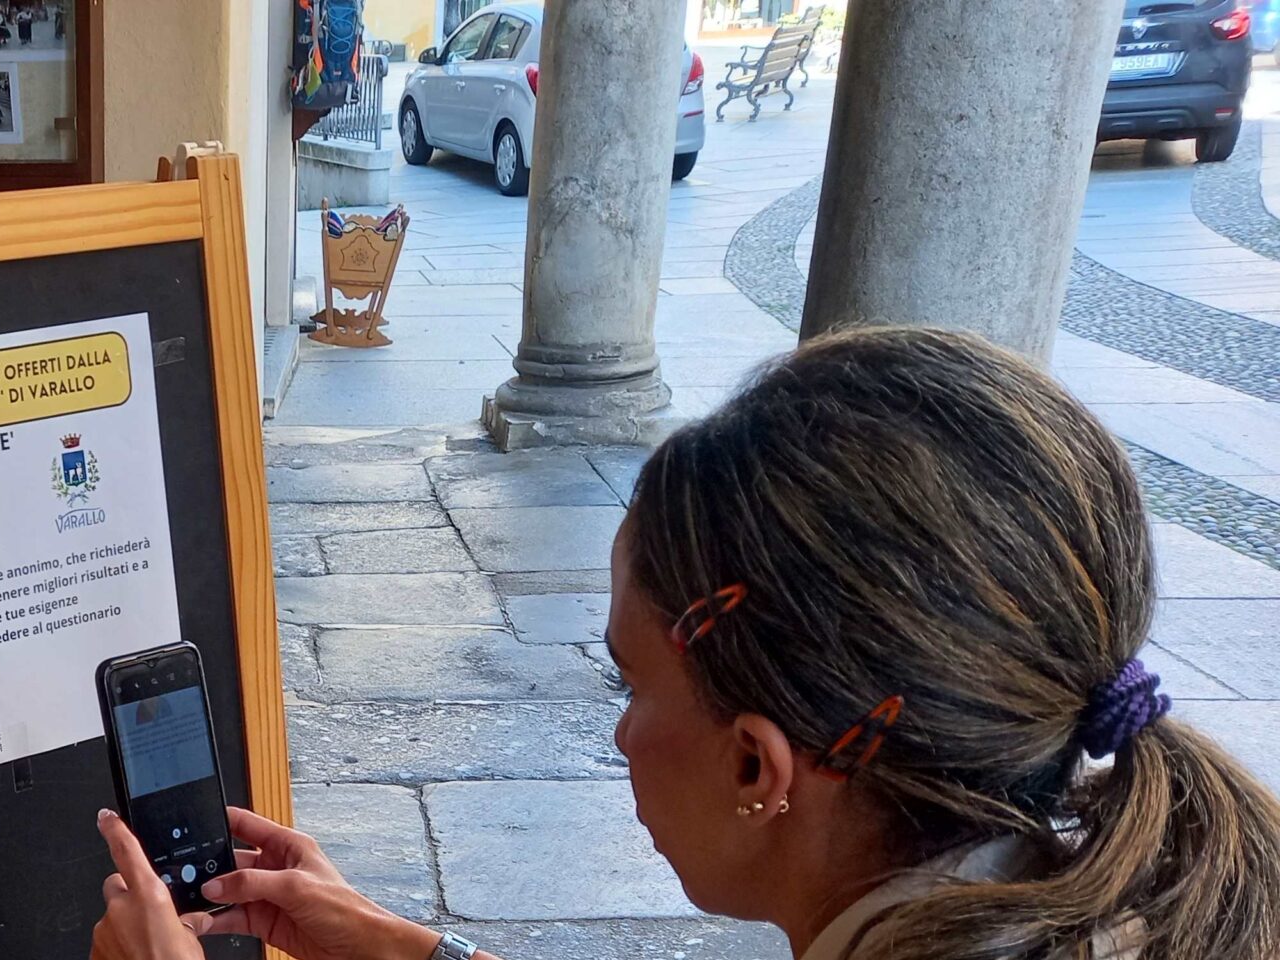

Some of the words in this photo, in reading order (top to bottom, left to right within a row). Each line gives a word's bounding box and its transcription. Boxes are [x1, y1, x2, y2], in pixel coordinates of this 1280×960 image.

[4, 357, 61, 380] OFFERTI
[66, 349, 112, 371] DALLA
[9, 388, 24, 404] DI
[28, 375, 95, 399] VARALLO
[0, 431, 14, 451] E'
[55, 508, 106, 534] VARALLO
[7, 558, 63, 580] anonimo,
[66, 550, 87, 566] che
[90, 537, 151, 561] richiederà
[33, 572, 78, 594] migliori
[81, 562, 129, 583] risultati
[132, 562, 139, 572] e
[142, 560, 149, 570] a
[5, 606, 26, 621] tue
[29, 595, 79, 615] esigenze
[32, 622, 42, 633] al
[46, 604, 121, 633] questionario
